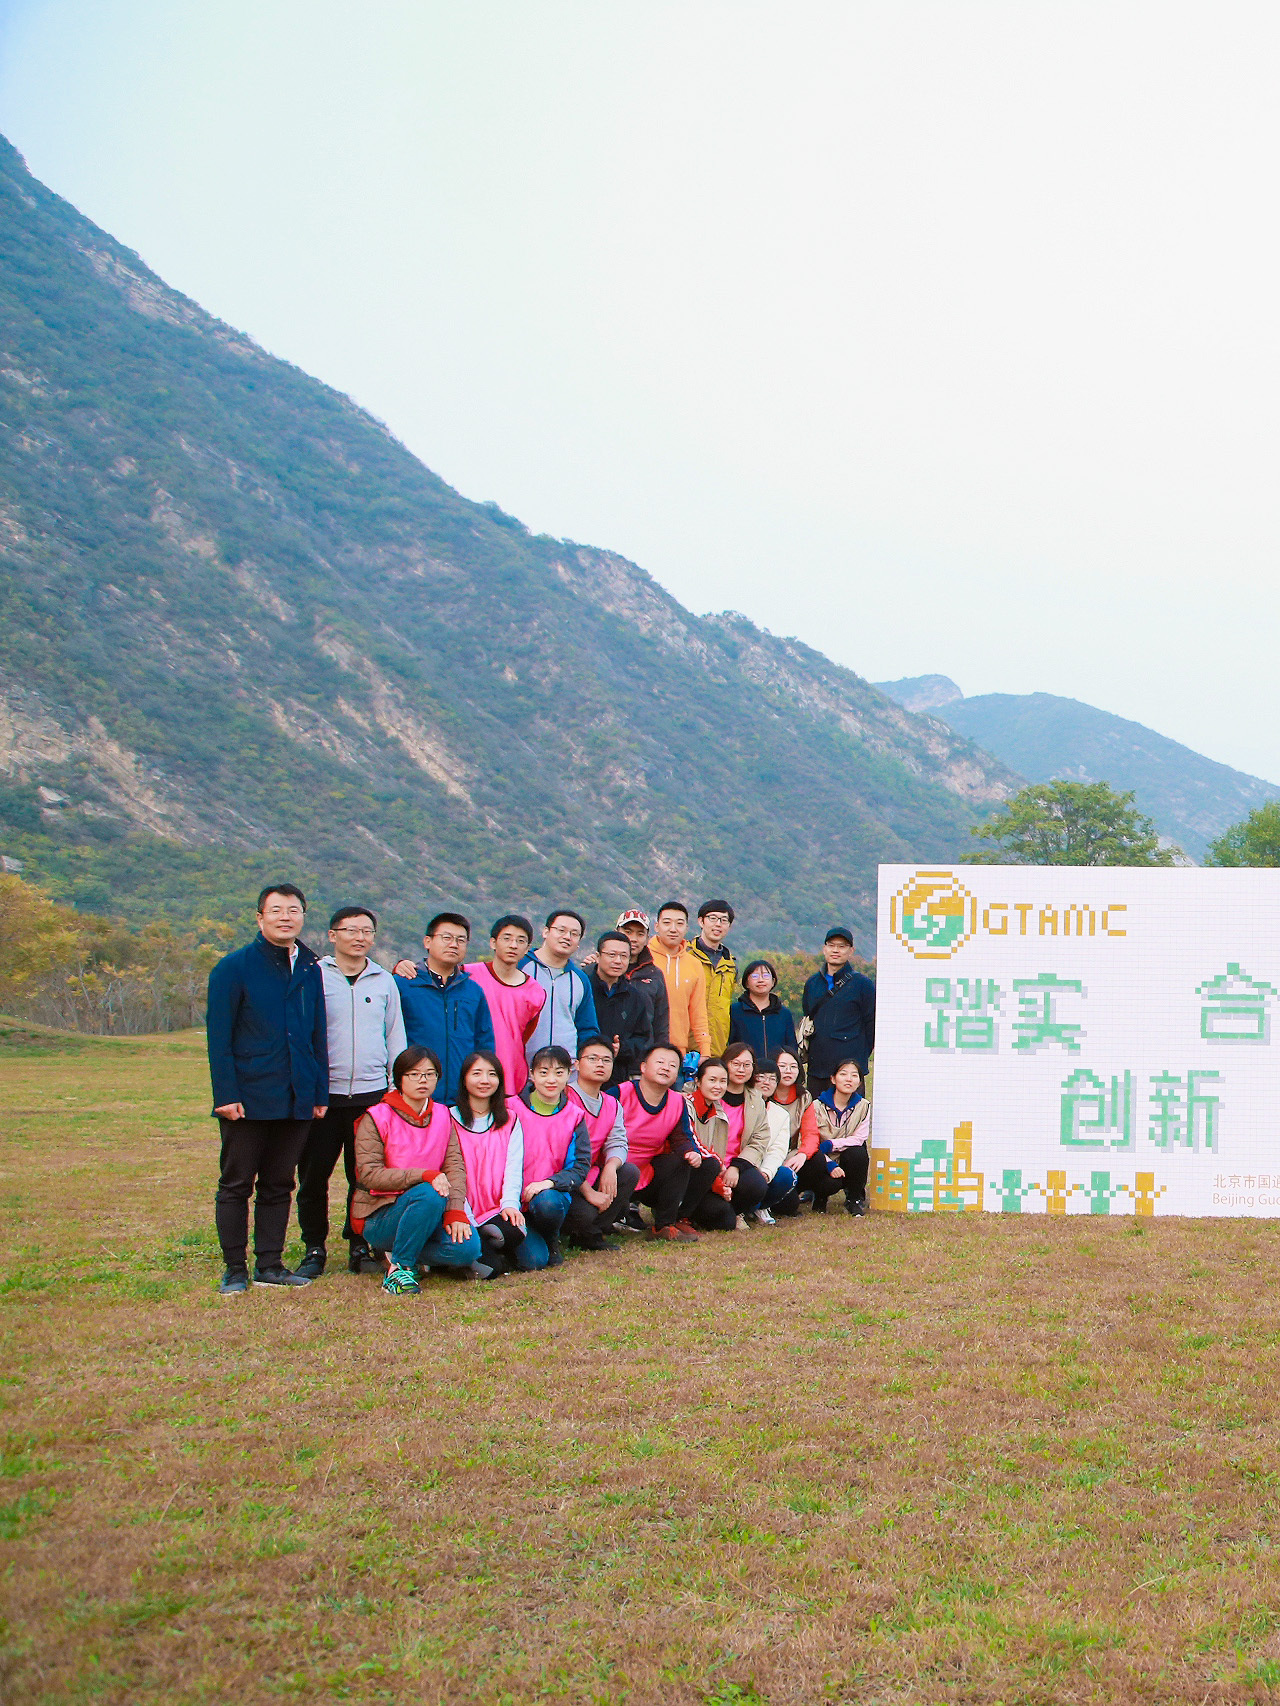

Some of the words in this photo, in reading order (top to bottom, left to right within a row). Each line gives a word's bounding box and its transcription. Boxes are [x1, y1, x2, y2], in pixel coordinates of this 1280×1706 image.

[983, 903, 1128, 936] GTAMC
[924, 972, 1088, 1055] 踏实
[1059, 1068, 1226, 1153] 创新
[1212, 1193, 1255, 1208] Beijing
